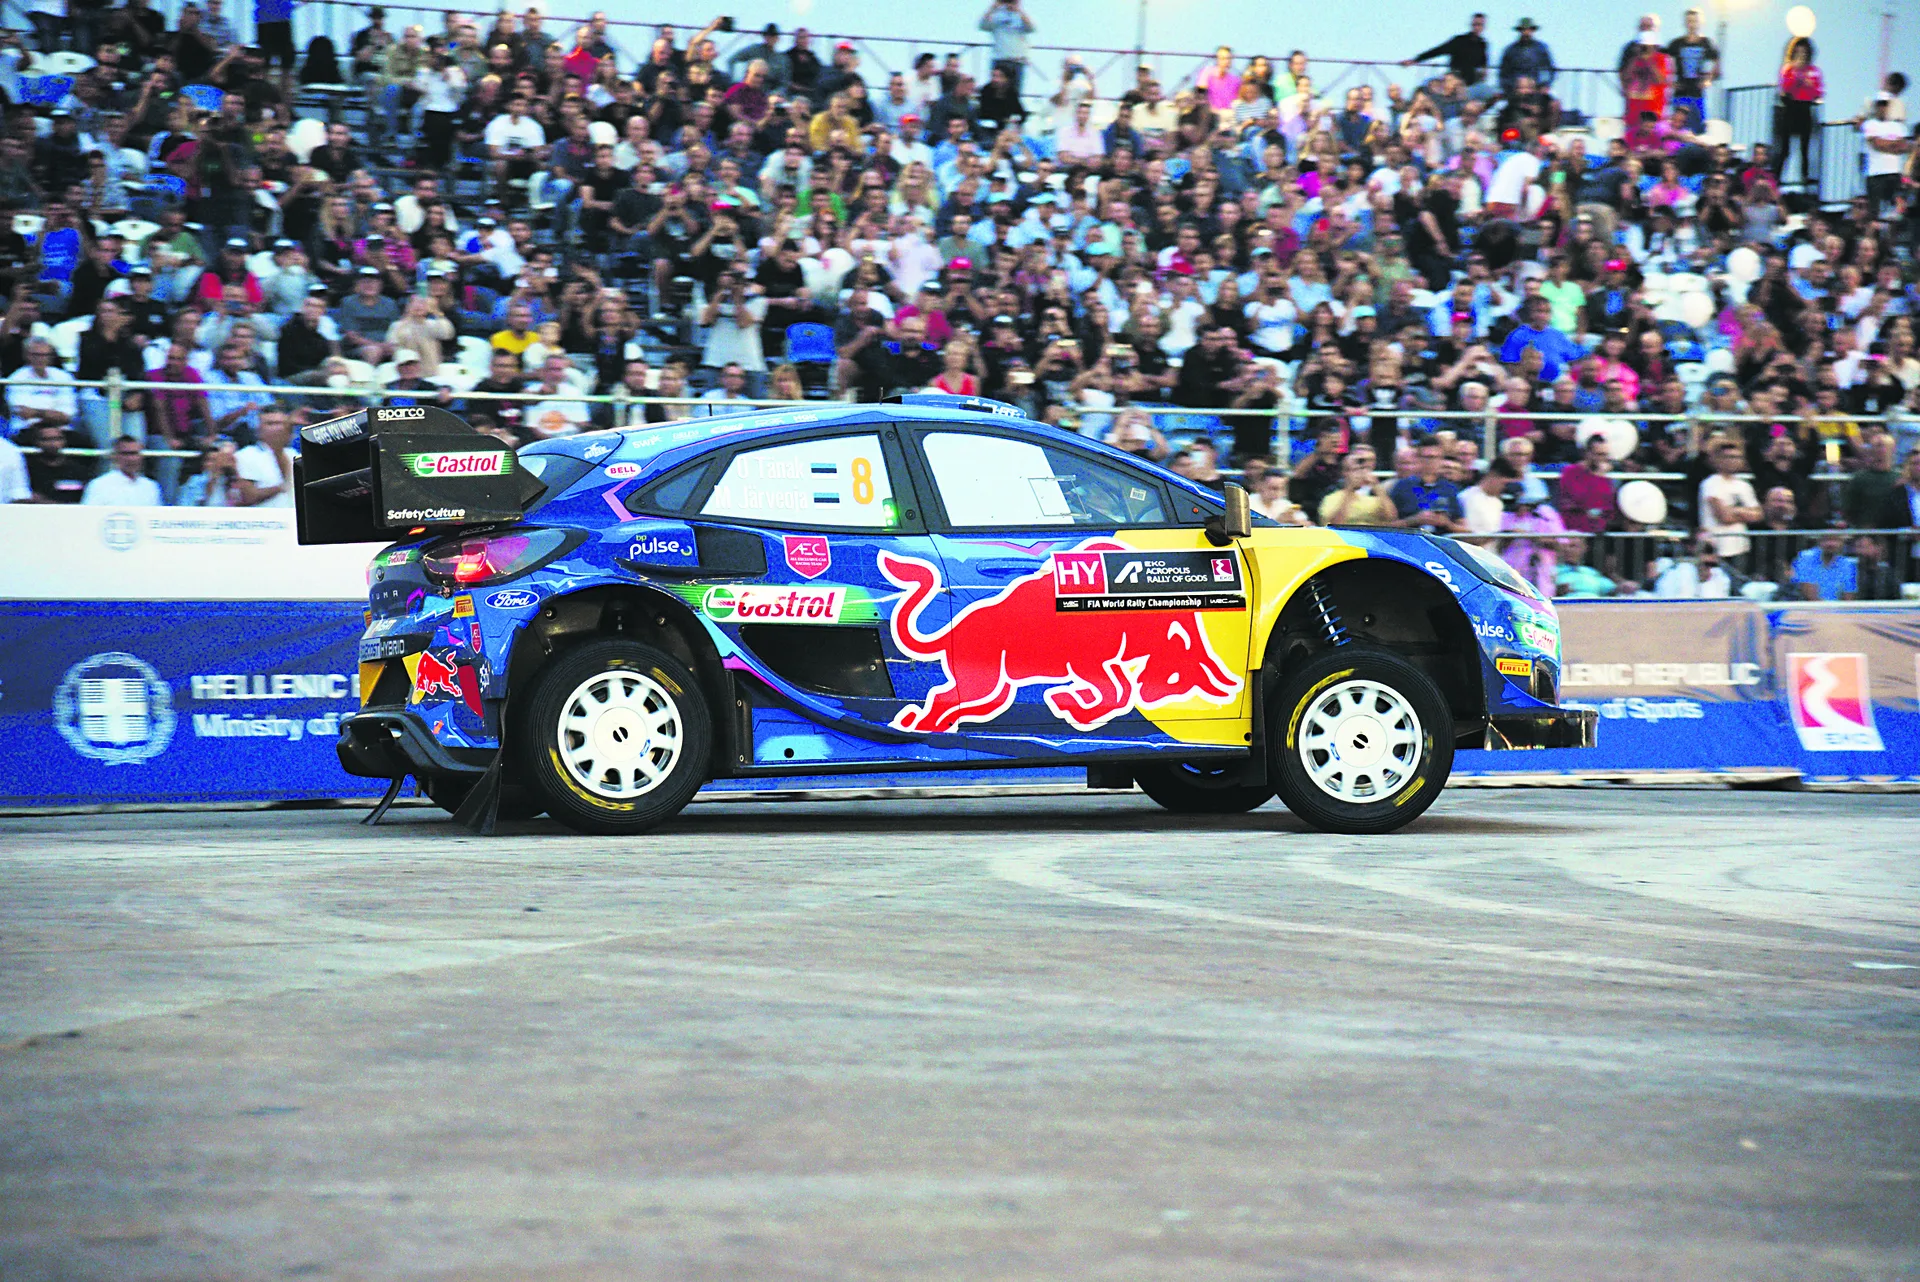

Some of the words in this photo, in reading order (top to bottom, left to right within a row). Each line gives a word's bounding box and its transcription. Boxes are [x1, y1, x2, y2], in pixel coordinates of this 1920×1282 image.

[377, 408, 425, 421] sparco
[436, 454, 498, 474] Castrol
[610, 466, 636, 474] BELL
[851, 457, 875, 505] 8
[714, 485, 732, 509] M
[387, 508, 466, 521] SafetyCulture
[629, 537, 680, 559] pulse
[1057, 560, 1100, 585] HY
[1146, 567, 1191, 575] ACROPOLIS
[1146, 575, 1170, 583] RALLY
[1172, 575, 1183, 583] OF
[1184, 574, 1208, 582] GODS
[494, 592, 530, 608] Ford
[737, 590, 834, 619] Castrol
[1087, 600, 1101, 608] FIA
[1102, 599, 1125, 608] World
[1126, 599, 1146, 609] Rally
[1148, 597, 1202, 608] Championship
[1499, 661, 1529, 673] PIRELLI
[190, 674, 349, 699] HELLENIC
[193, 714, 304, 741] Ministry
